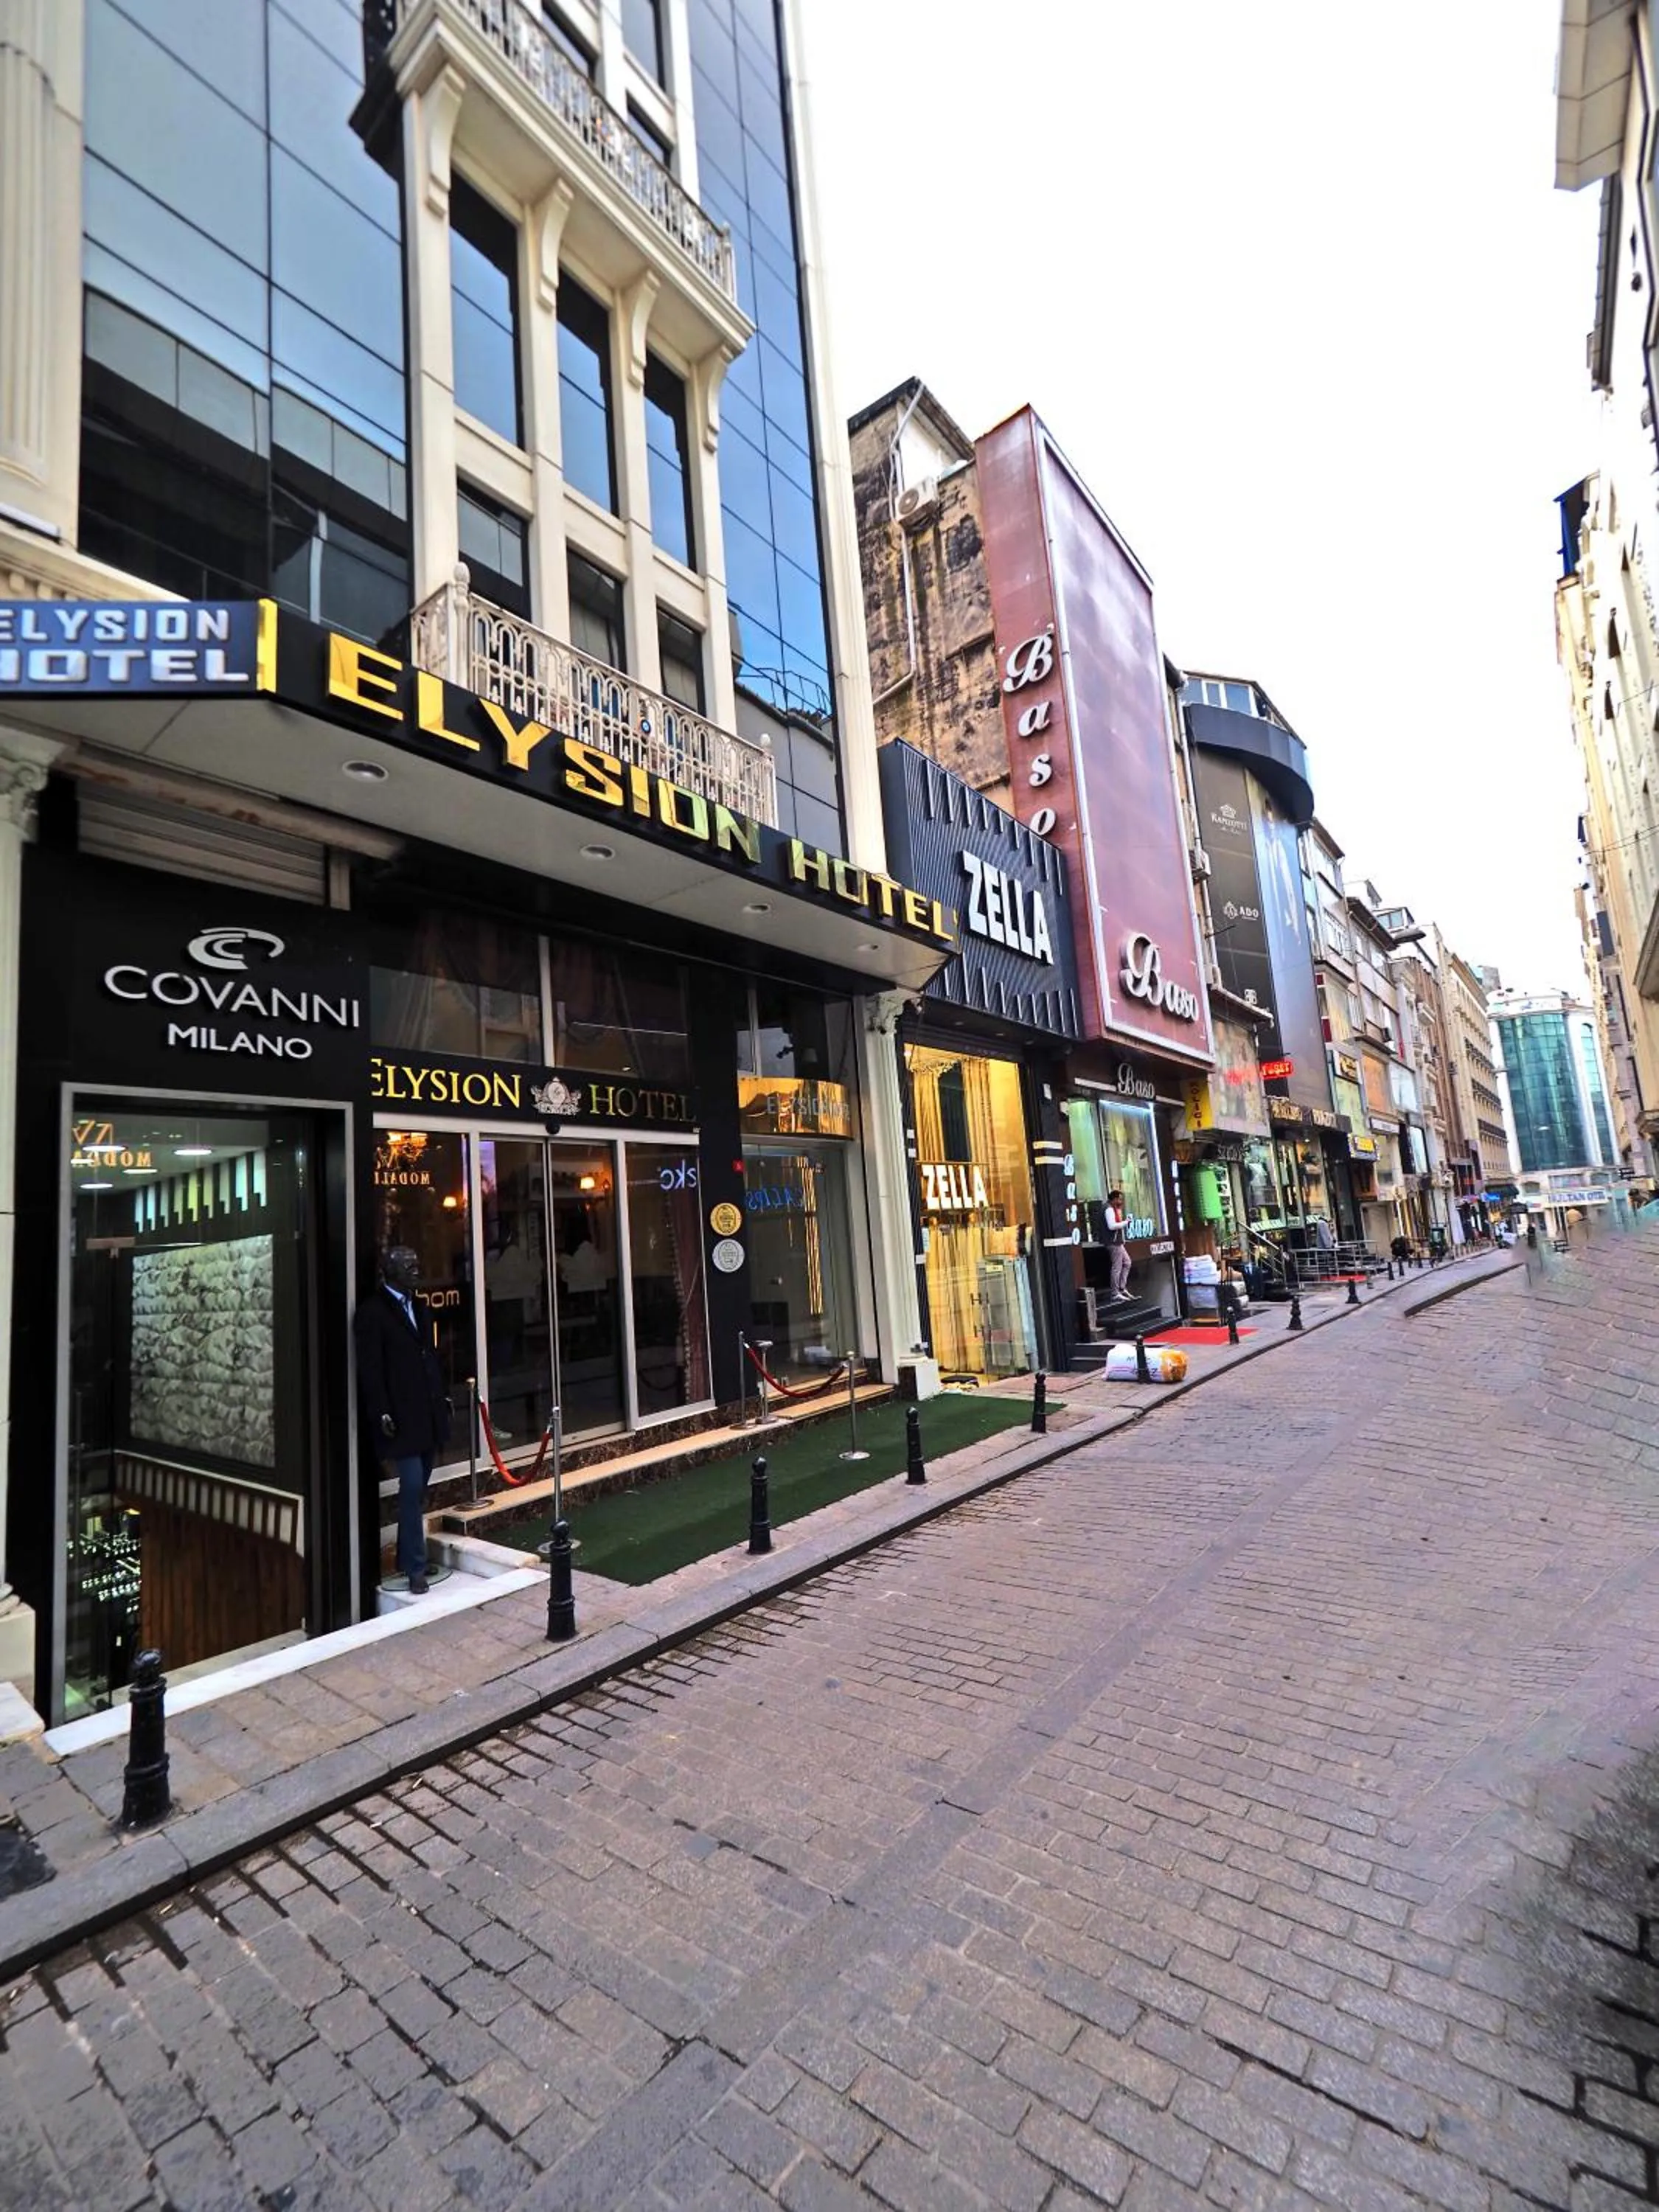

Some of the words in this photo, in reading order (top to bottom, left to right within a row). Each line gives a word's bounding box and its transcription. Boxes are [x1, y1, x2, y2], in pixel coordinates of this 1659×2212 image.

[0, 609, 230, 641] ELYSION
[1002, 633, 1056, 835] Baso
[327, 631, 761, 864] ELYSION
[787, 838, 953, 942] HOTEL
[961, 849, 1055, 966] ZELLA
[104, 964, 360, 1028] COVANNI
[1119, 932, 1200, 1022] Baso
[167, 1023, 313, 1060] MILANO
[371, 1057, 522, 1108] ELYSION
[588, 1083, 697, 1123] HOTEL
[1118, 1062, 1155, 1098] Baso
[922, 1164, 989, 1210] ZELLA
